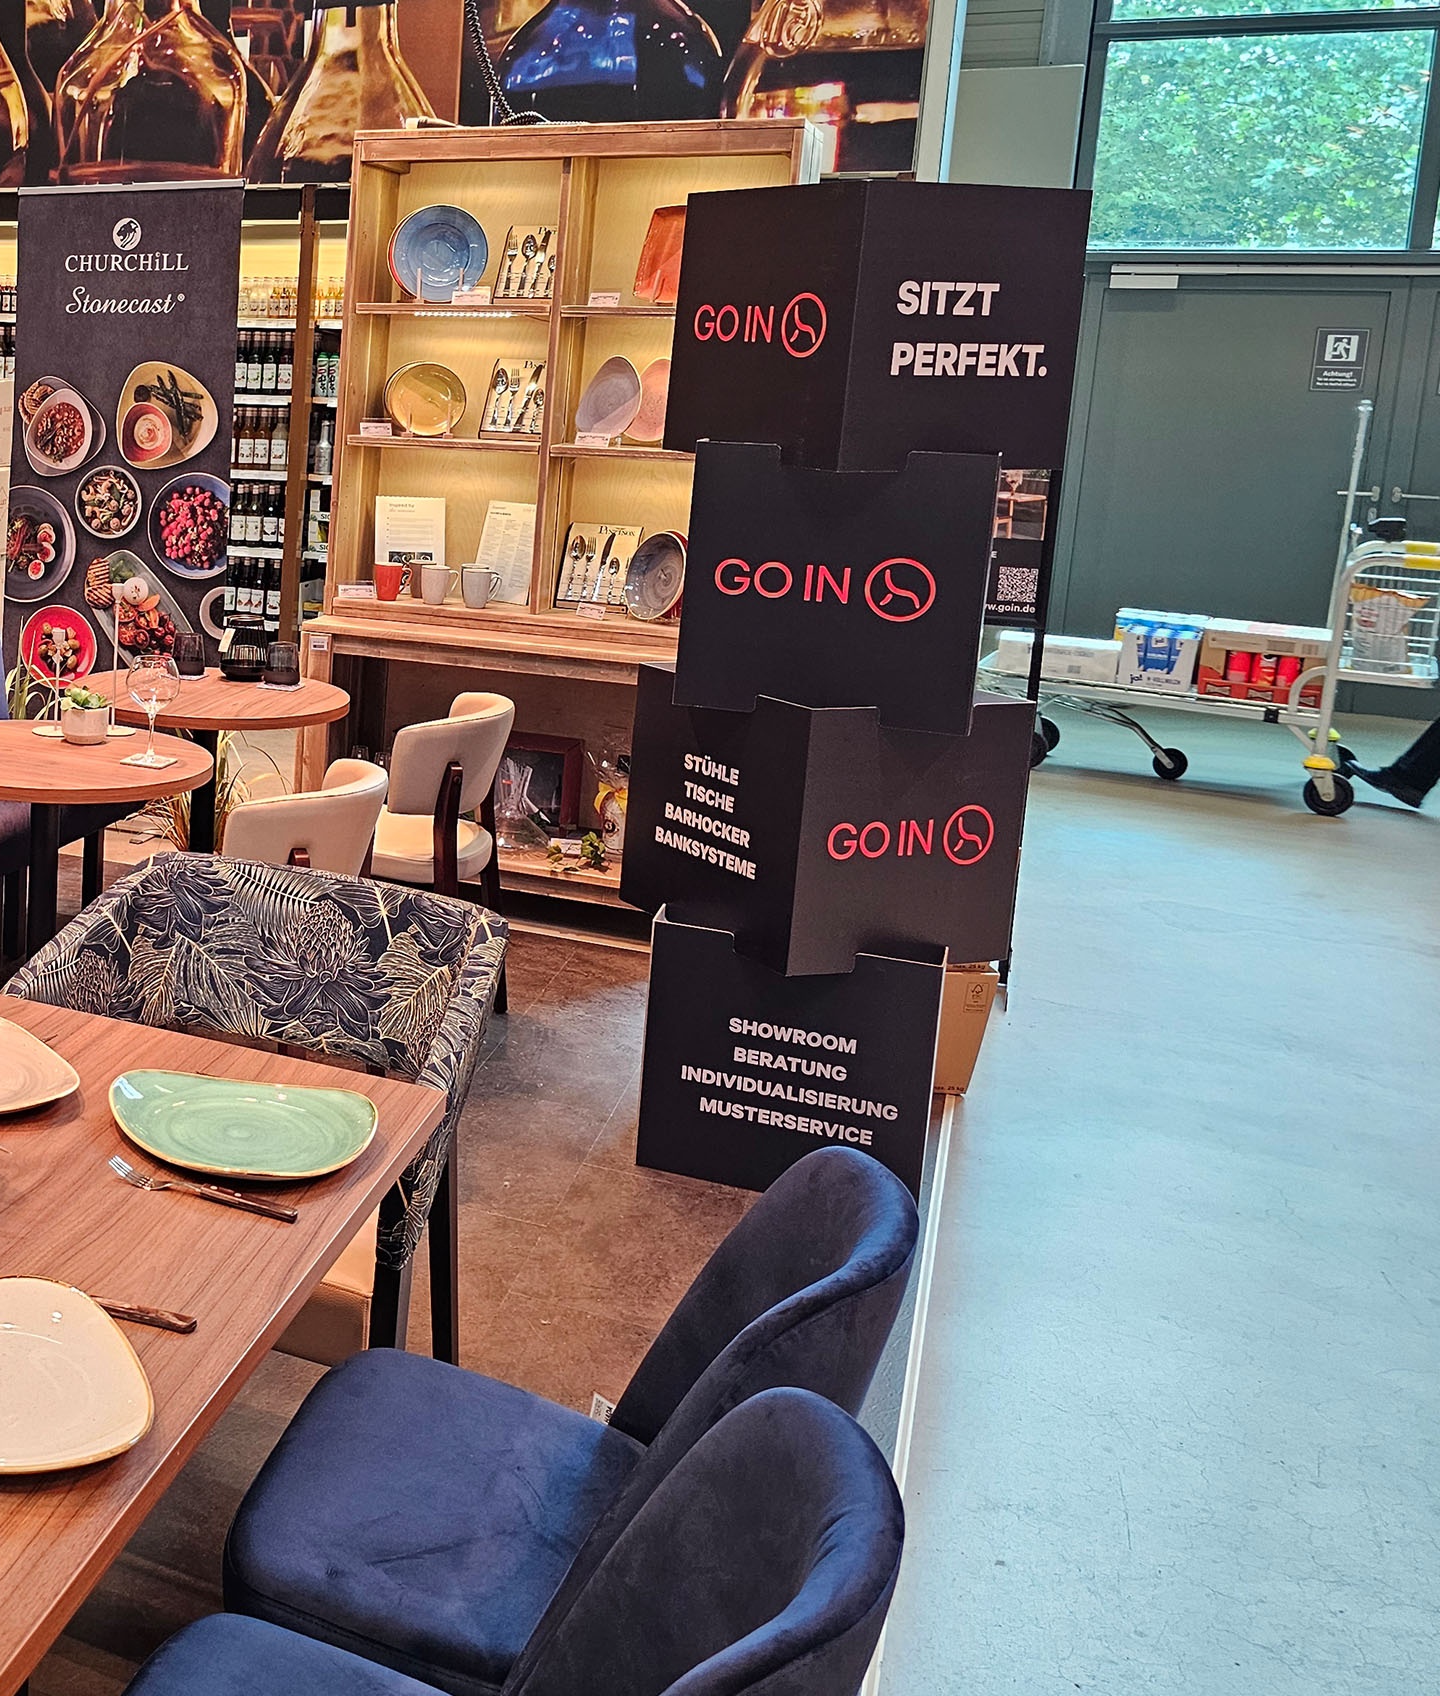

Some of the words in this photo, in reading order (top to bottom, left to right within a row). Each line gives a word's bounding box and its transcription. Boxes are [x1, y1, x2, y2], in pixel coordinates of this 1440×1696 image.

[896, 279, 1000, 317] SITZT
[694, 304, 740, 343] GO
[744, 305, 774, 344] IN
[890, 342, 1048, 378] PERFEKT.
[714, 558, 793, 599] GO
[803, 564, 852, 604] IN
[984, 603, 1036, 613] w.goin.de
[684, 753, 739, 786] STÜHLE
[684, 781, 735, 813] TISCHE
[664, 802, 750, 848] BARHOCKER
[827, 820, 890, 860] GO
[897, 818, 934, 856] IN
[655, 825, 757, 881] BANKSYSTEME
[728, 1016, 858, 1055] SHOWROOM
[733, 1046, 848, 1082] BERATUNG
[681, 1065, 899, 1121] INDIVIDUALISIERUNG
[699, 1096, 873, 1146] MUSTERSERVICE
